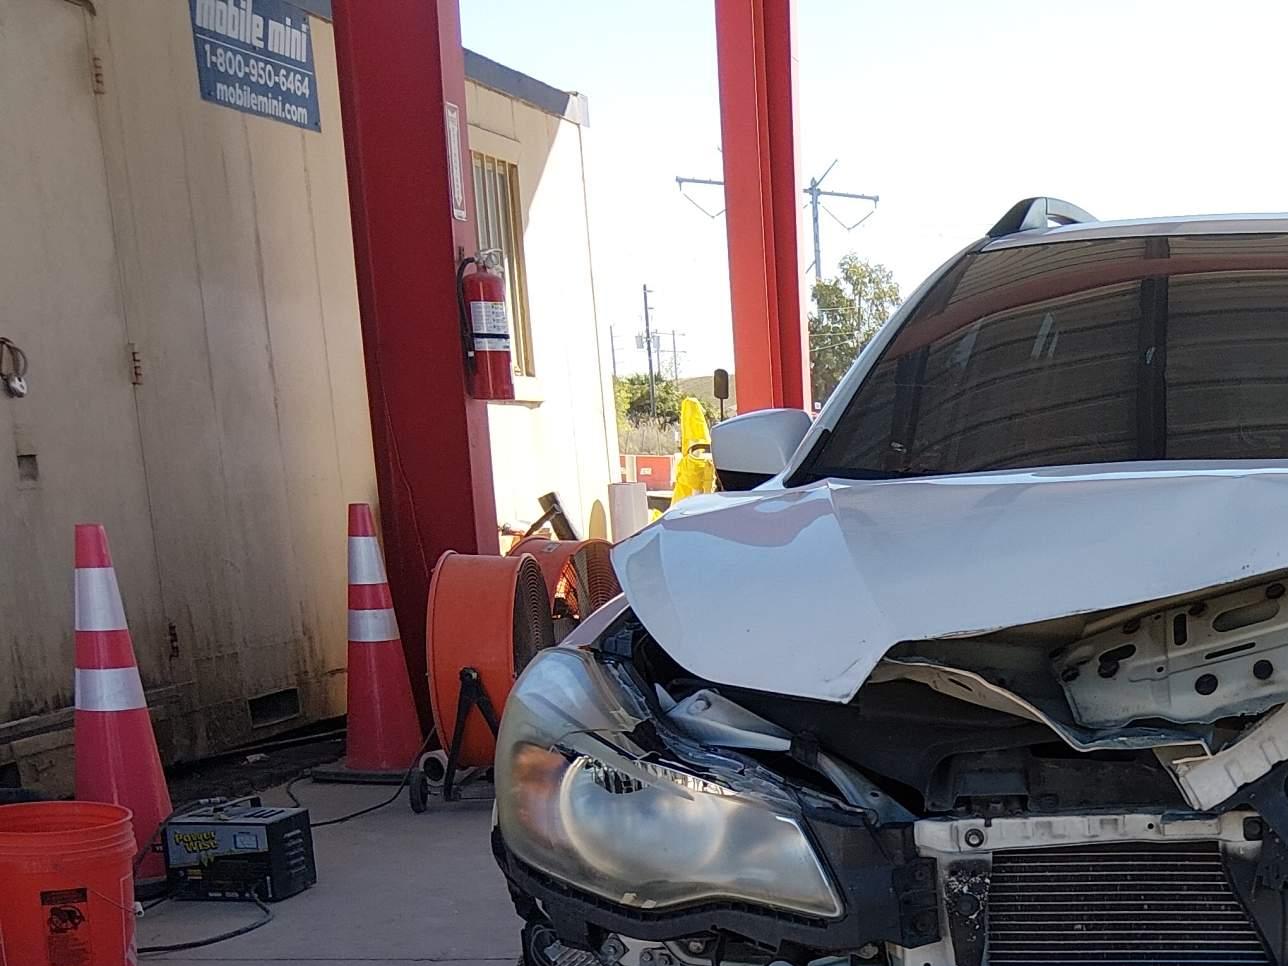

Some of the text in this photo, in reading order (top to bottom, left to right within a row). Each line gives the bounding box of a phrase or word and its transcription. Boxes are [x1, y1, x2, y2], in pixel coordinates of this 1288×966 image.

[196, 0, 308, 63] mobile mini
[204, 43, 310, 98] 1-800-950-6464
[216, 82, 308, 125] mobilemini.com
